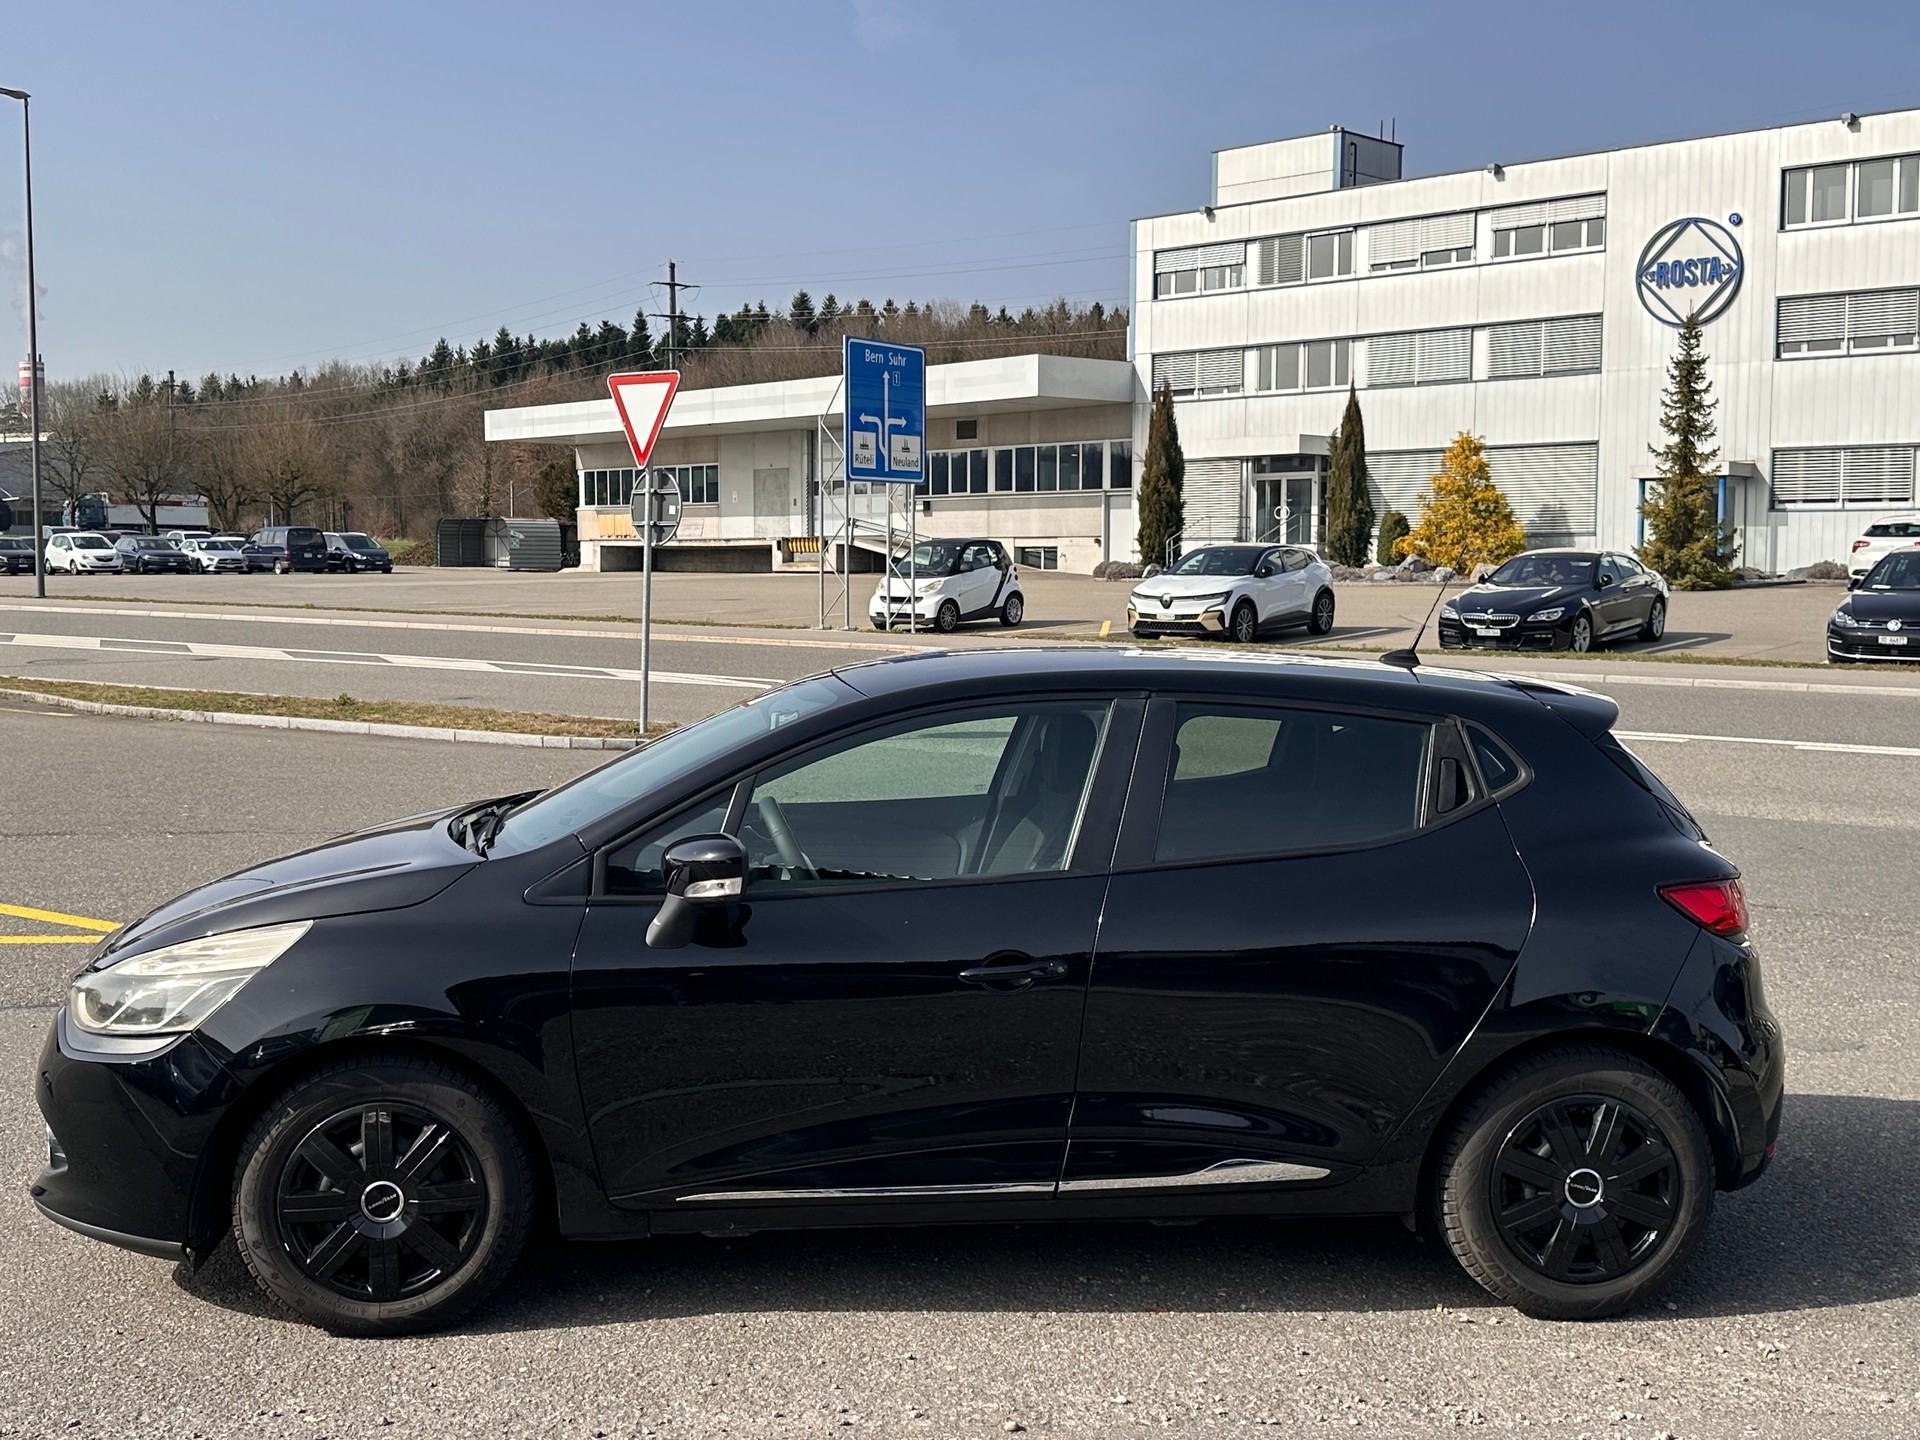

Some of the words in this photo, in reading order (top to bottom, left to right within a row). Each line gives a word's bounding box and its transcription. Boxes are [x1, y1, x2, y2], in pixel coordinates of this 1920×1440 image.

[865, 349, 884, 364] Bern
[888, 352, 907, 367] Suhr
[855, 453, 874, 466] Rüteli
[893, 456, 919, 468] Neuland
